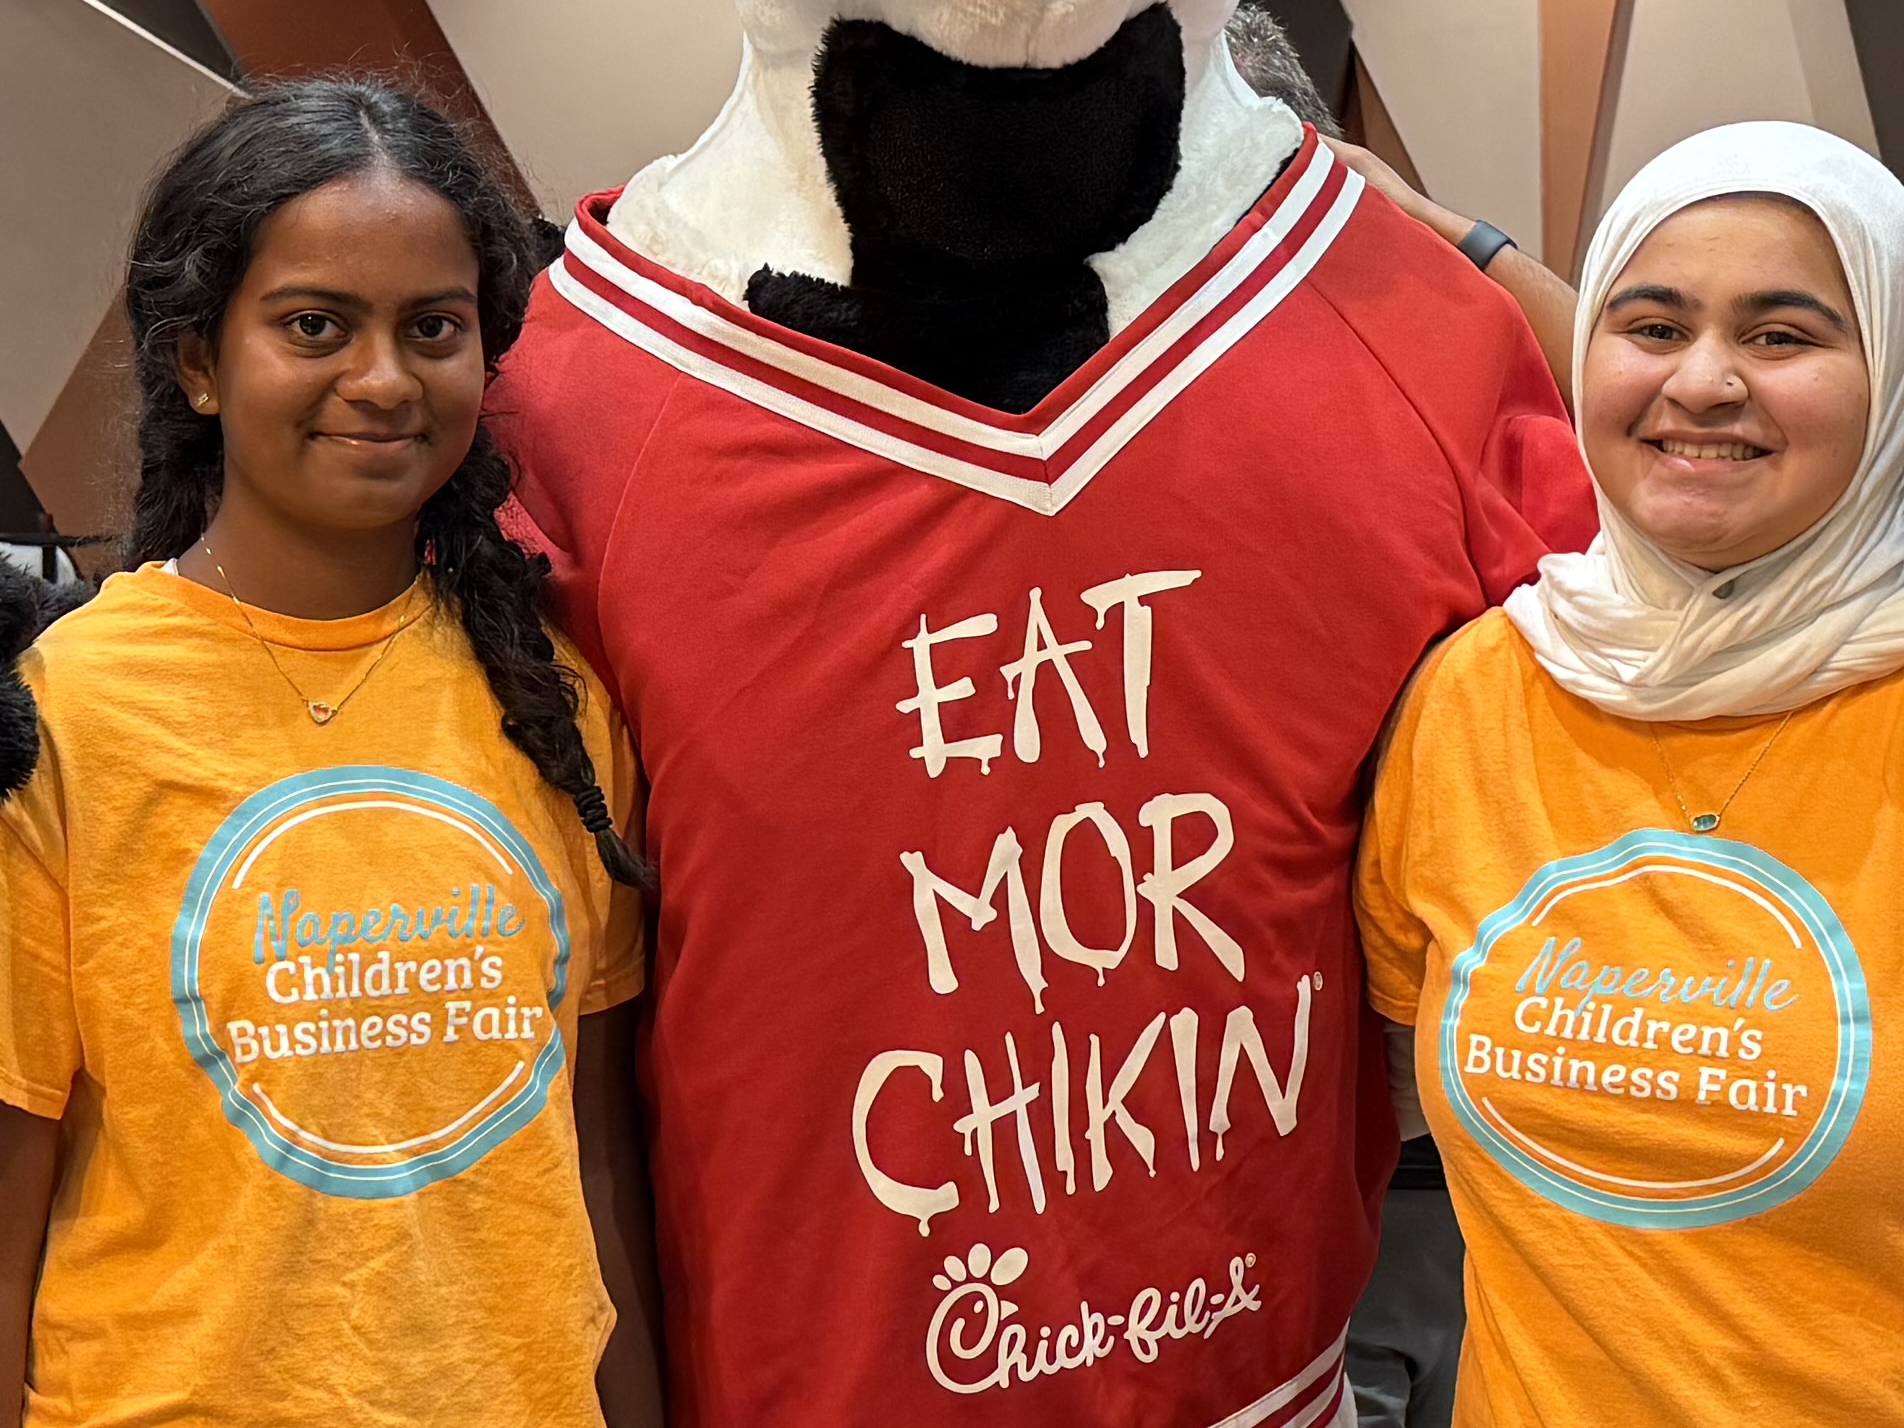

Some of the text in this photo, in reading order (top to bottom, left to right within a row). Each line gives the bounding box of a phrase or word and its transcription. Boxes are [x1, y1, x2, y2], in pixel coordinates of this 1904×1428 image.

[895, 569, 1202, 779] EAT
[253, 882, 526, 973] Naperville
[899, 792, 1245, 1014] MOR
[265, 945, 503, 1005] Children's
[1515, 935, 1799, 1016] Naperville
[226, 996, 544, 1064] Business Fair
[1513, 995, 1764, 1061] Children's
[851, 973, 1313, 1238] CHIKIN
[1463, 1033, 1808, 1118] Business Fair
[925, 1255, 1263, 1395] Chick-fil-A
